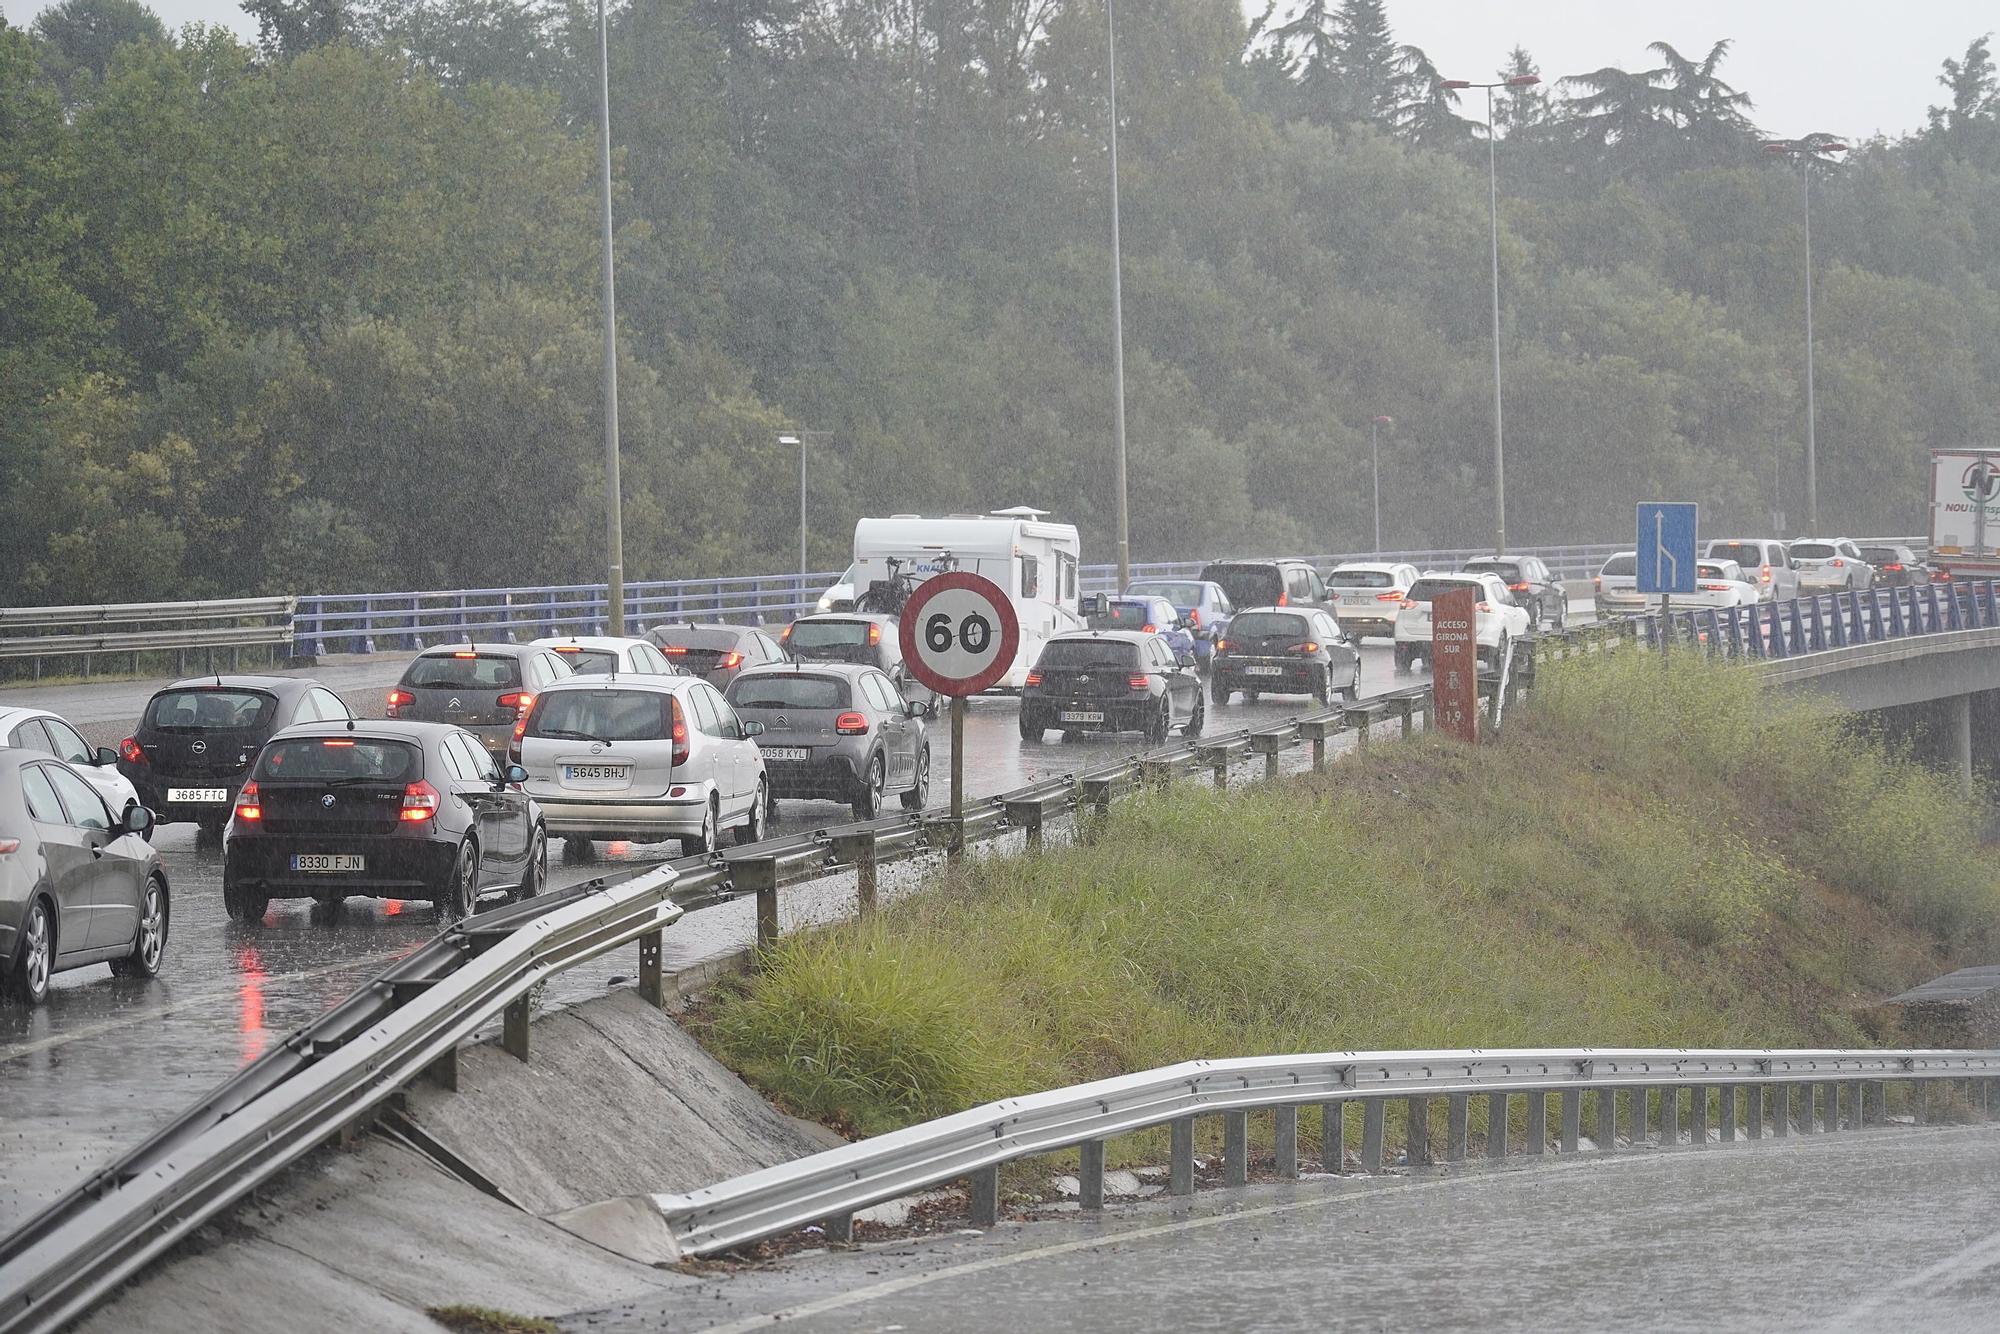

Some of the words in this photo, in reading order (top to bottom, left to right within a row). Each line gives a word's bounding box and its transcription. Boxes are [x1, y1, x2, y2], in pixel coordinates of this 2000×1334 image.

[1437, 621, 1468, 629] ACCESO
[925, 613, 991, 654] 60
[1436, 633, 1468, 641] GIRONA
[1444, 645, 1460, 653] SUR
[786, 749, 804, 759] KYL
[573, 767, 601, 778] 5645
[603, 768, 625, 778] BHJ
[175, 790, 202, 800] 3685
[204, 790, 224, 800] FTC
[299, 856, 329, 869] 8330
[335, 856, 360, 869] FJN
